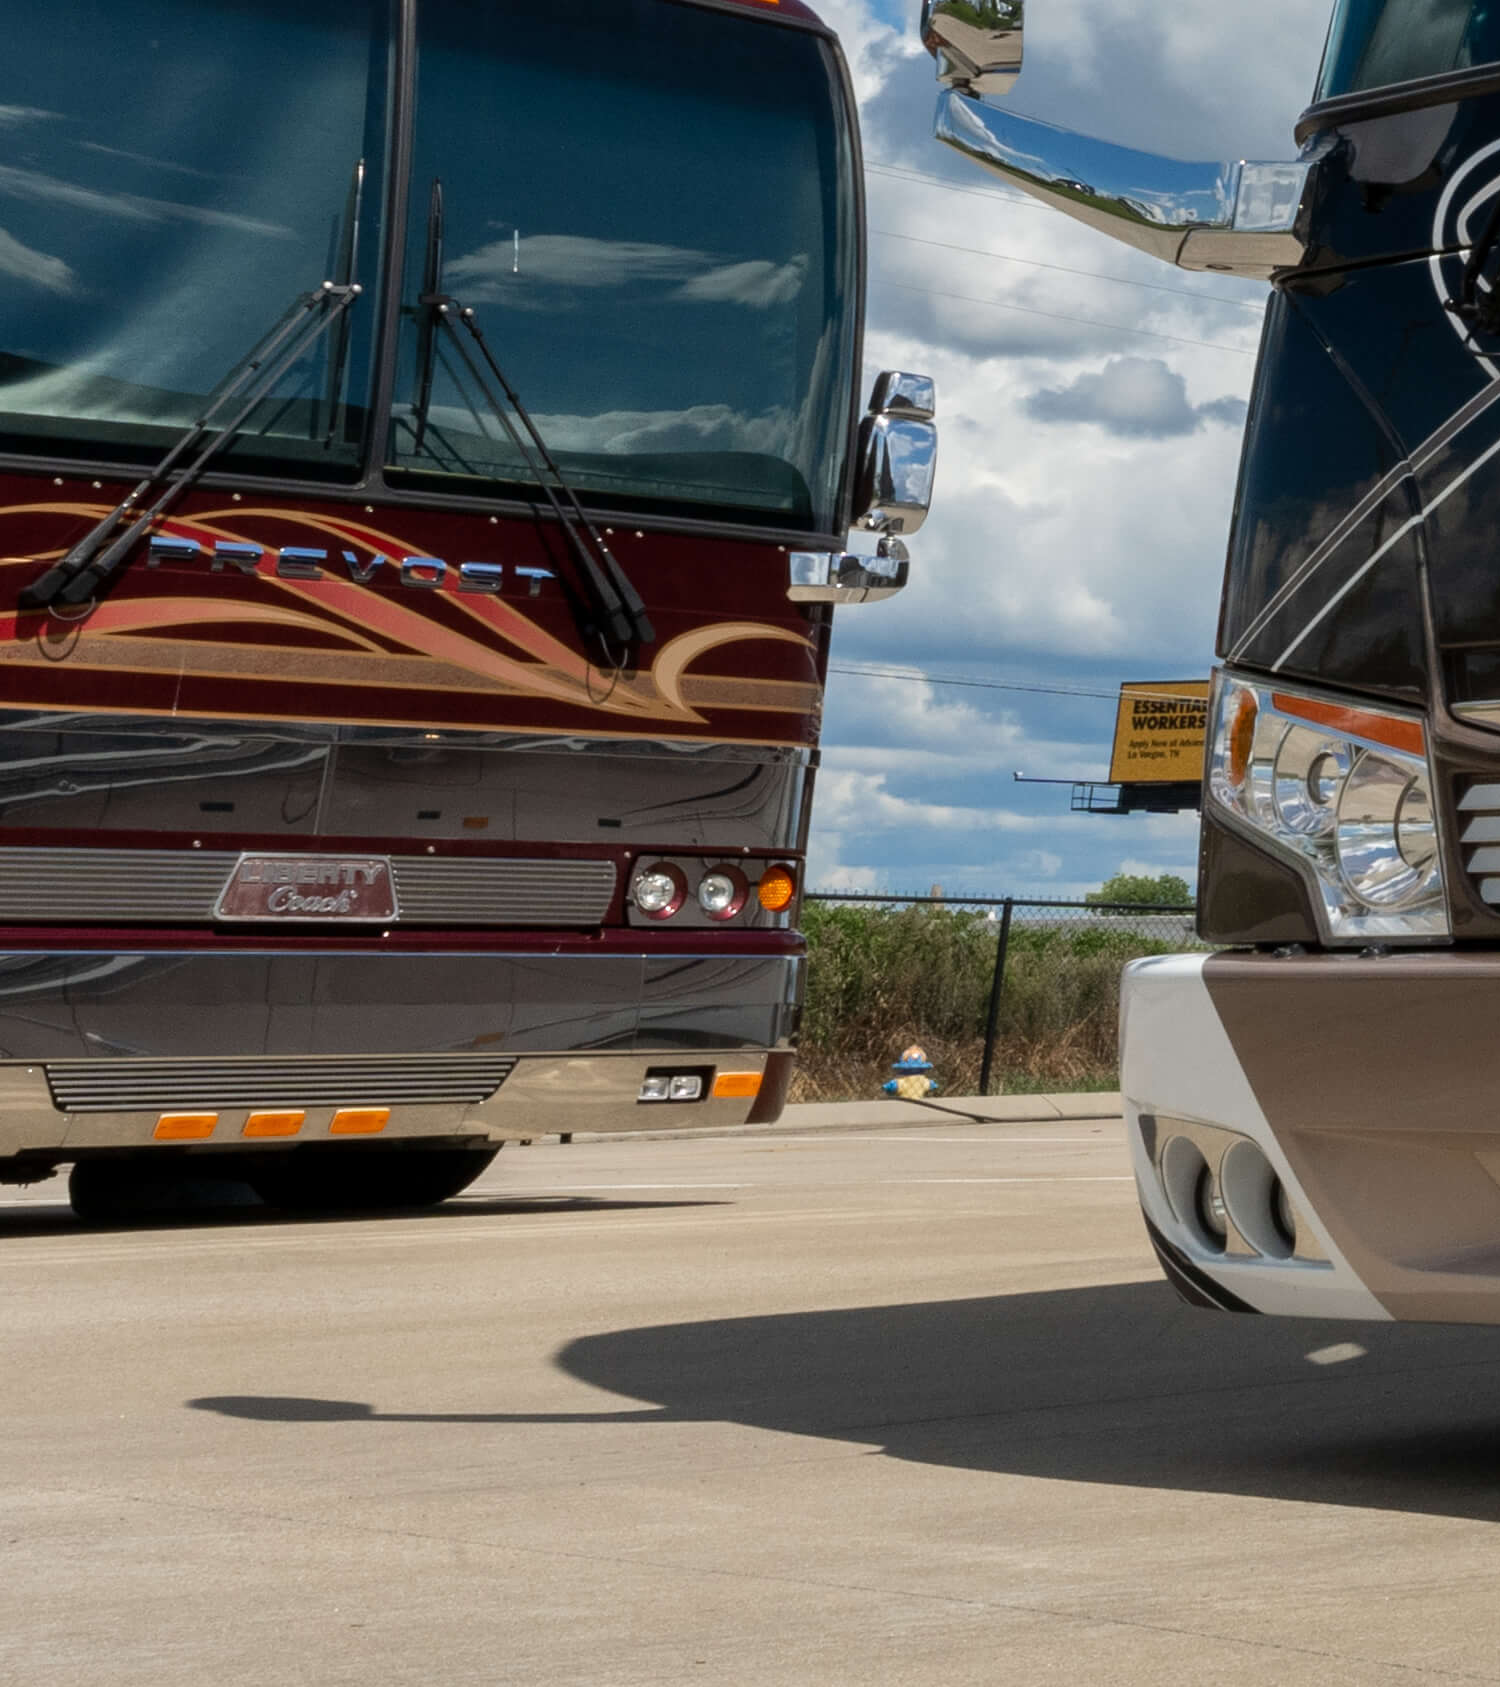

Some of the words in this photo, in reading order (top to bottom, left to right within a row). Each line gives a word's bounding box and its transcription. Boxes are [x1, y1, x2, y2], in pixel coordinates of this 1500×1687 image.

[146, 535, 558, 598] PREVOST
[1132, 714, 1207, 731] WORKERS
[239, 862, 386, 885] LIBERTY
